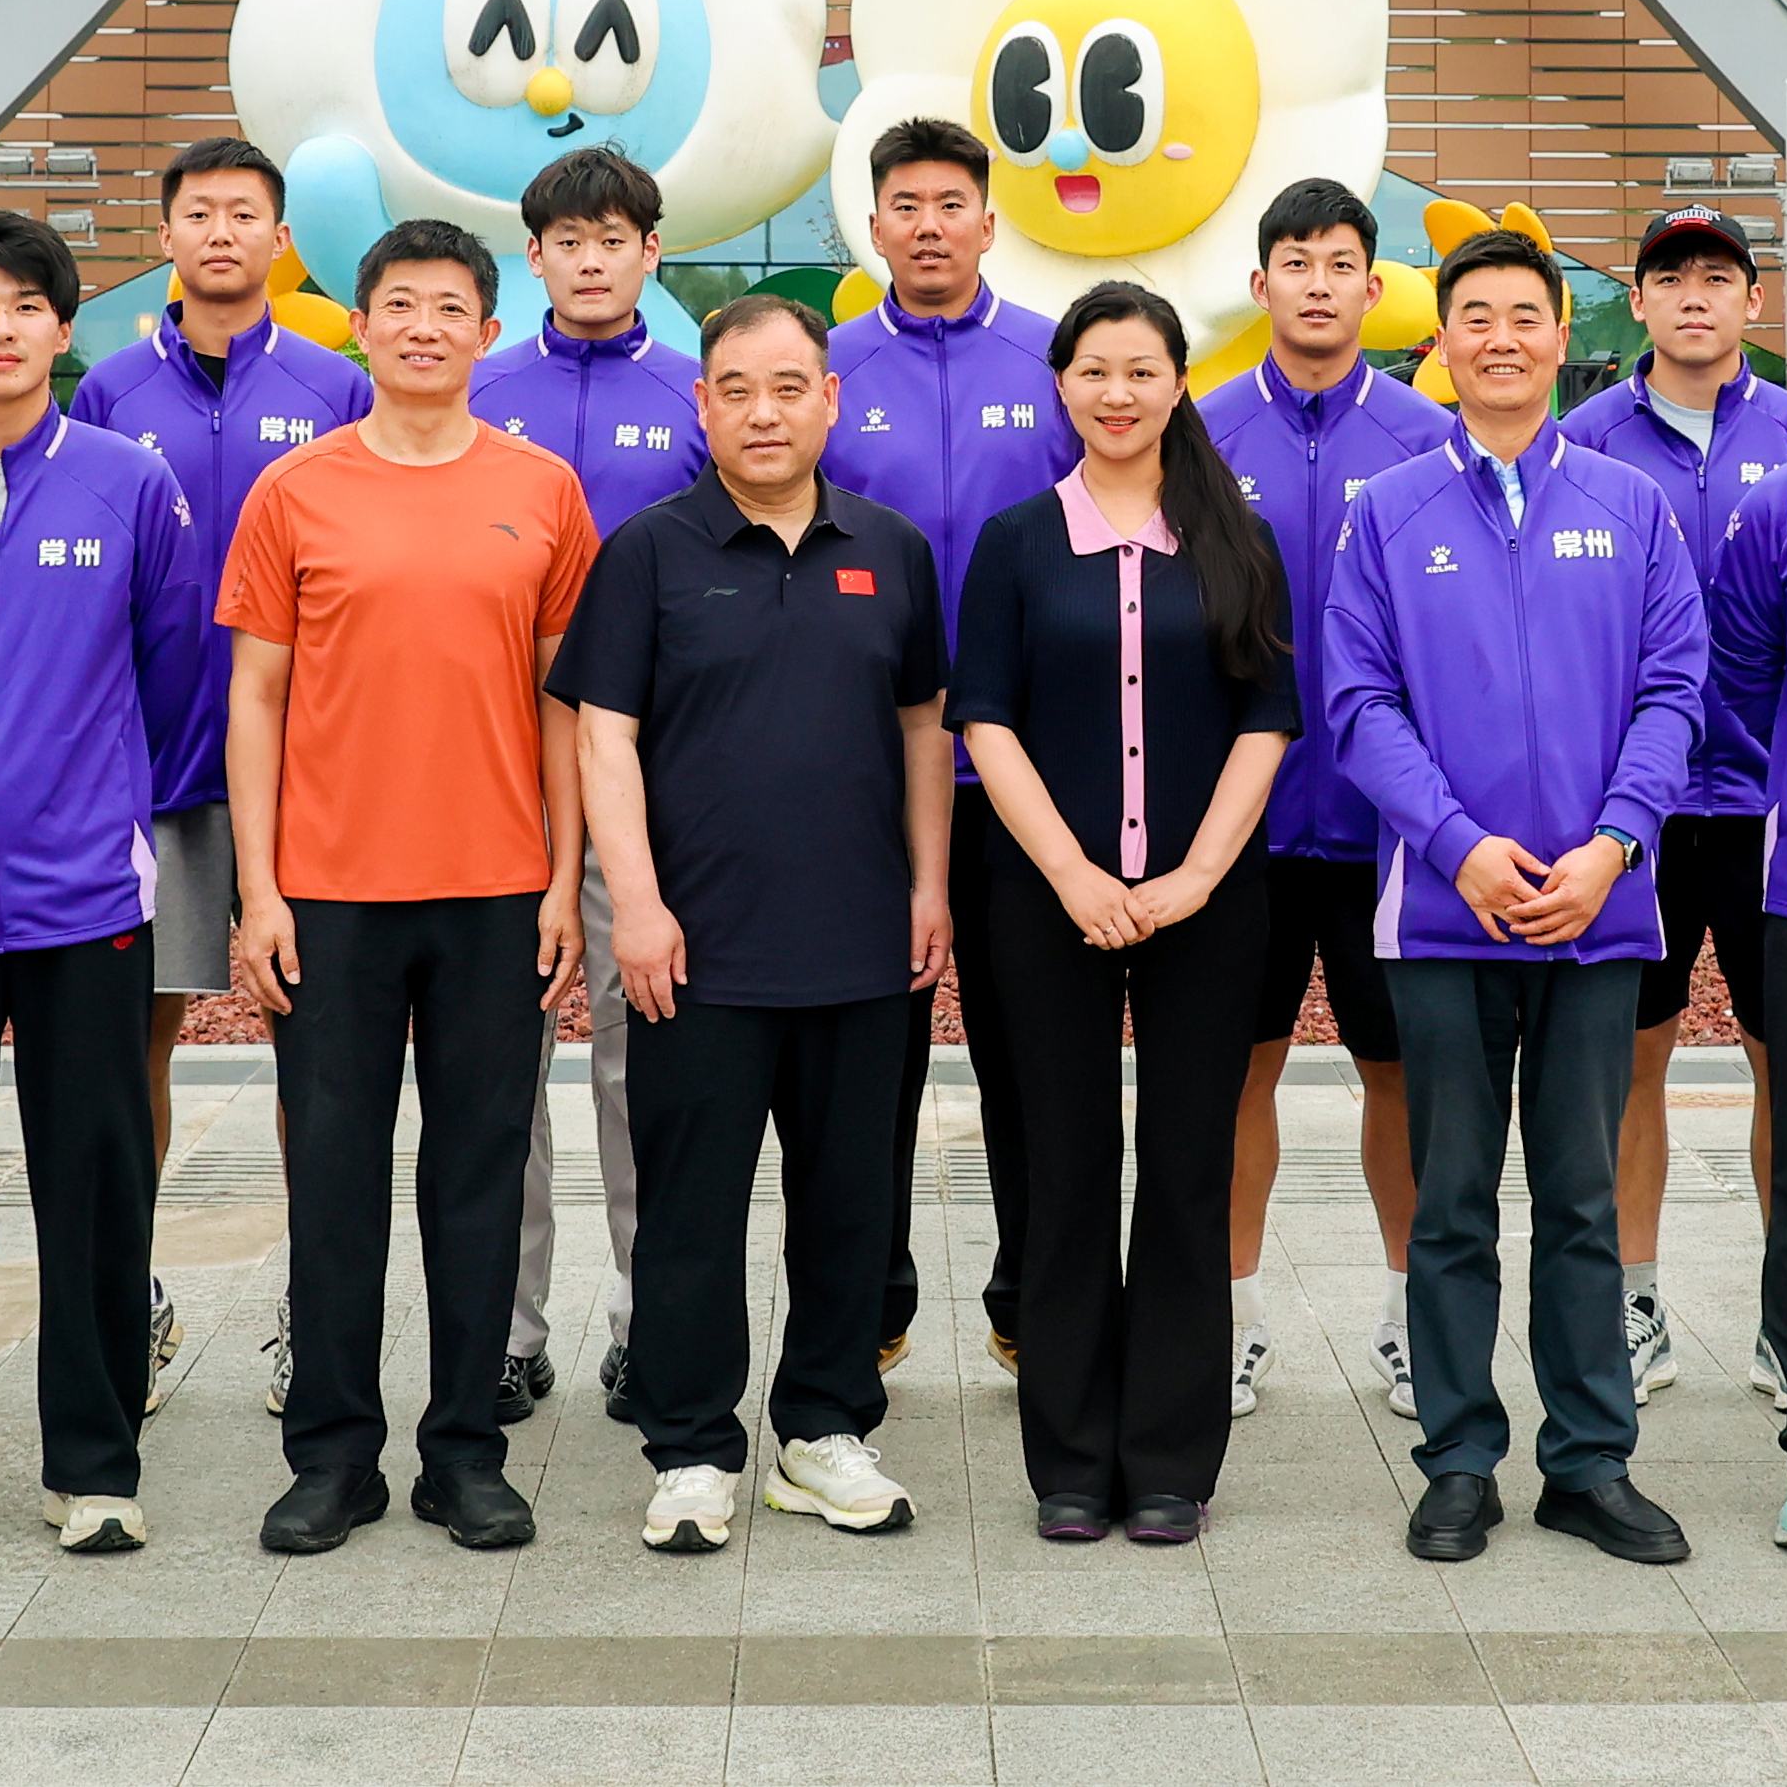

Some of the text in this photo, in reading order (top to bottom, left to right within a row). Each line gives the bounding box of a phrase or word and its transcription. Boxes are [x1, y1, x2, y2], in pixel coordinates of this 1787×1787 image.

[860, 424, 891, 432] KELME
[981, 403, 1034, 428] 常州
[260, 416, 313, 444] 常州
[615, 424, 671, 450] 常州
[1740, 462, 1779, 484] 常
[38, 539, 100, 566] 常州
[1552, 529, 1613, 558] 常州
[1426, 563, 1459, 573] KELME
